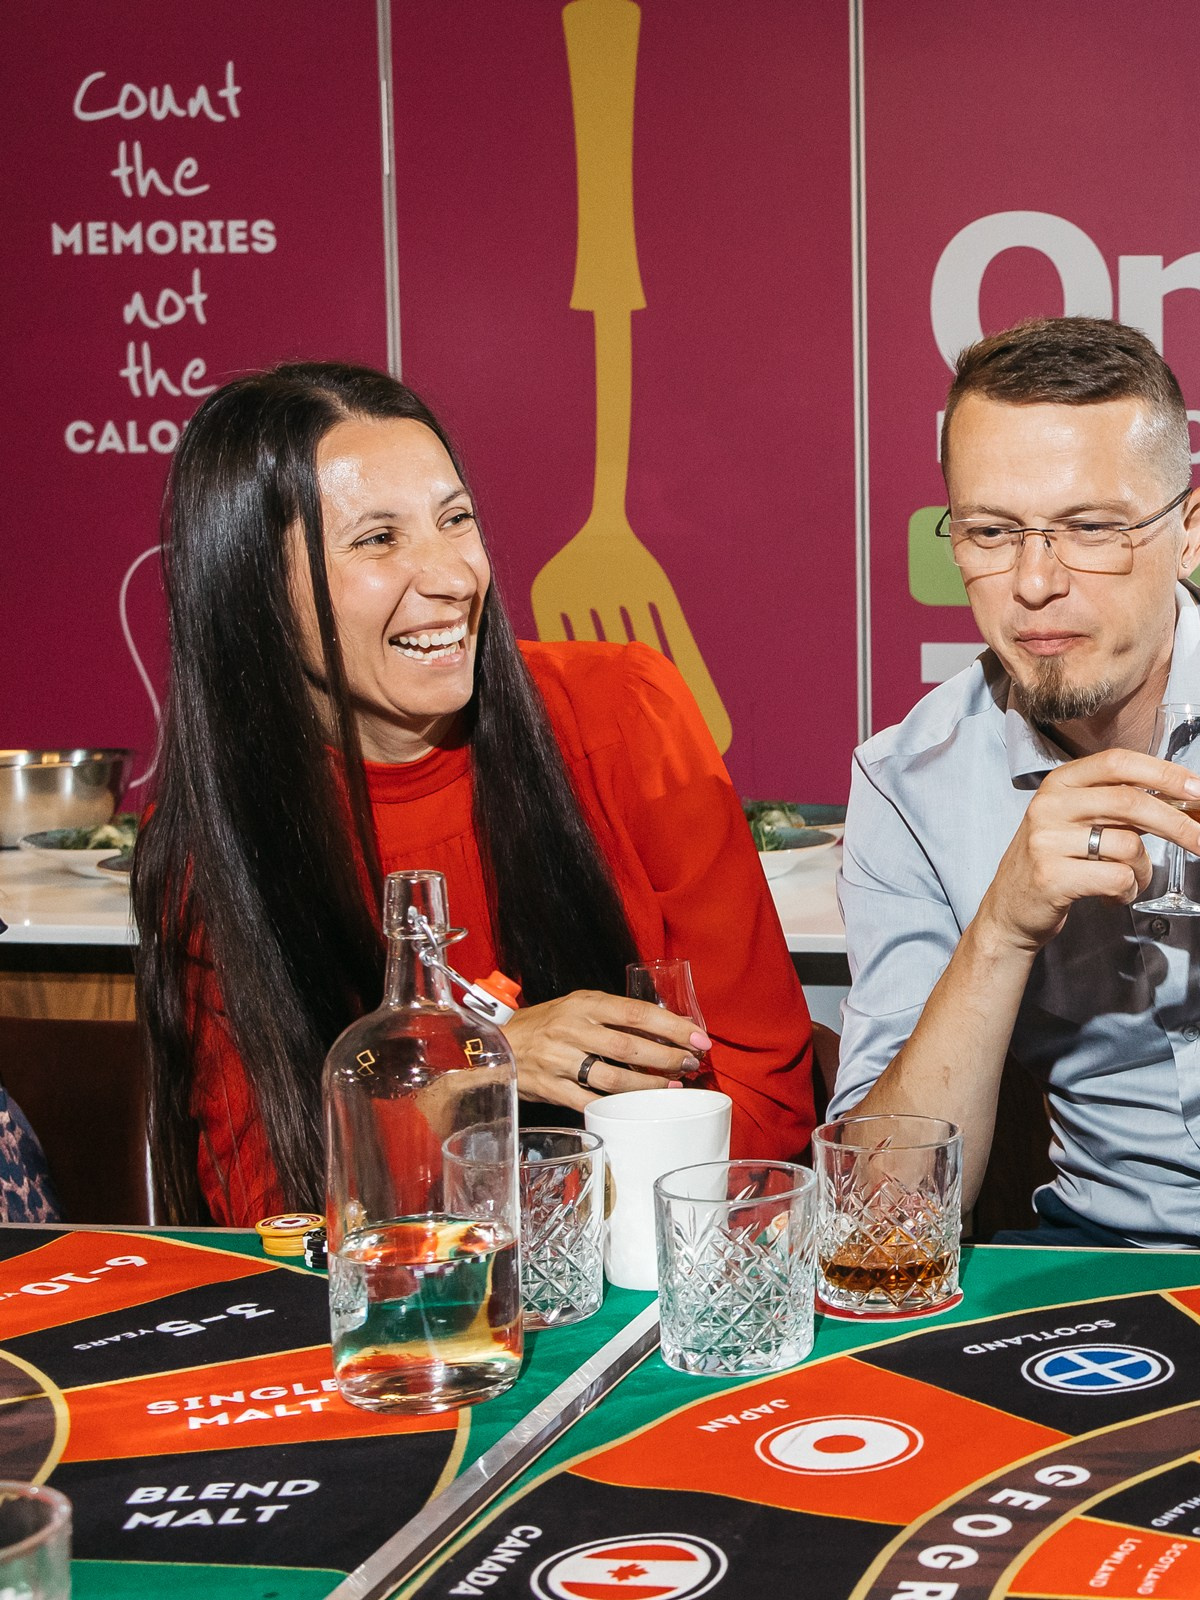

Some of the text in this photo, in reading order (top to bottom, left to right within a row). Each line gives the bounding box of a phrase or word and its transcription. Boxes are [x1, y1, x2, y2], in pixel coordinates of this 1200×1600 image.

[73, 60, 242, 122] Count
[111, 140, 210, 197] the
[51, 219, 278, 255] MEMORIES
[123, 268, 208, 329] not
[118, 341, 219, 397] the
[19, 1255, 149, 1295] 6-10
[72, 1302, 275, 1351] 3-5 YEARS
[962, 1318, 1117, 1355] SCOTLAND
[146, 1378, 339, 1415] SINGLE
[188, 1397, 330, 1430] MALT
[696, 1398, 791, 1433] JAPAN
[125, 1479, 321, 1505] BLEND
[121, 1504, 290, 1530] MALT
[448, 1524, 543, 1597] CANADA
[1089, 1537, 1143, 1588] LOWLAND
[1137, 1542, 1188, 1595] SCOTLAND
